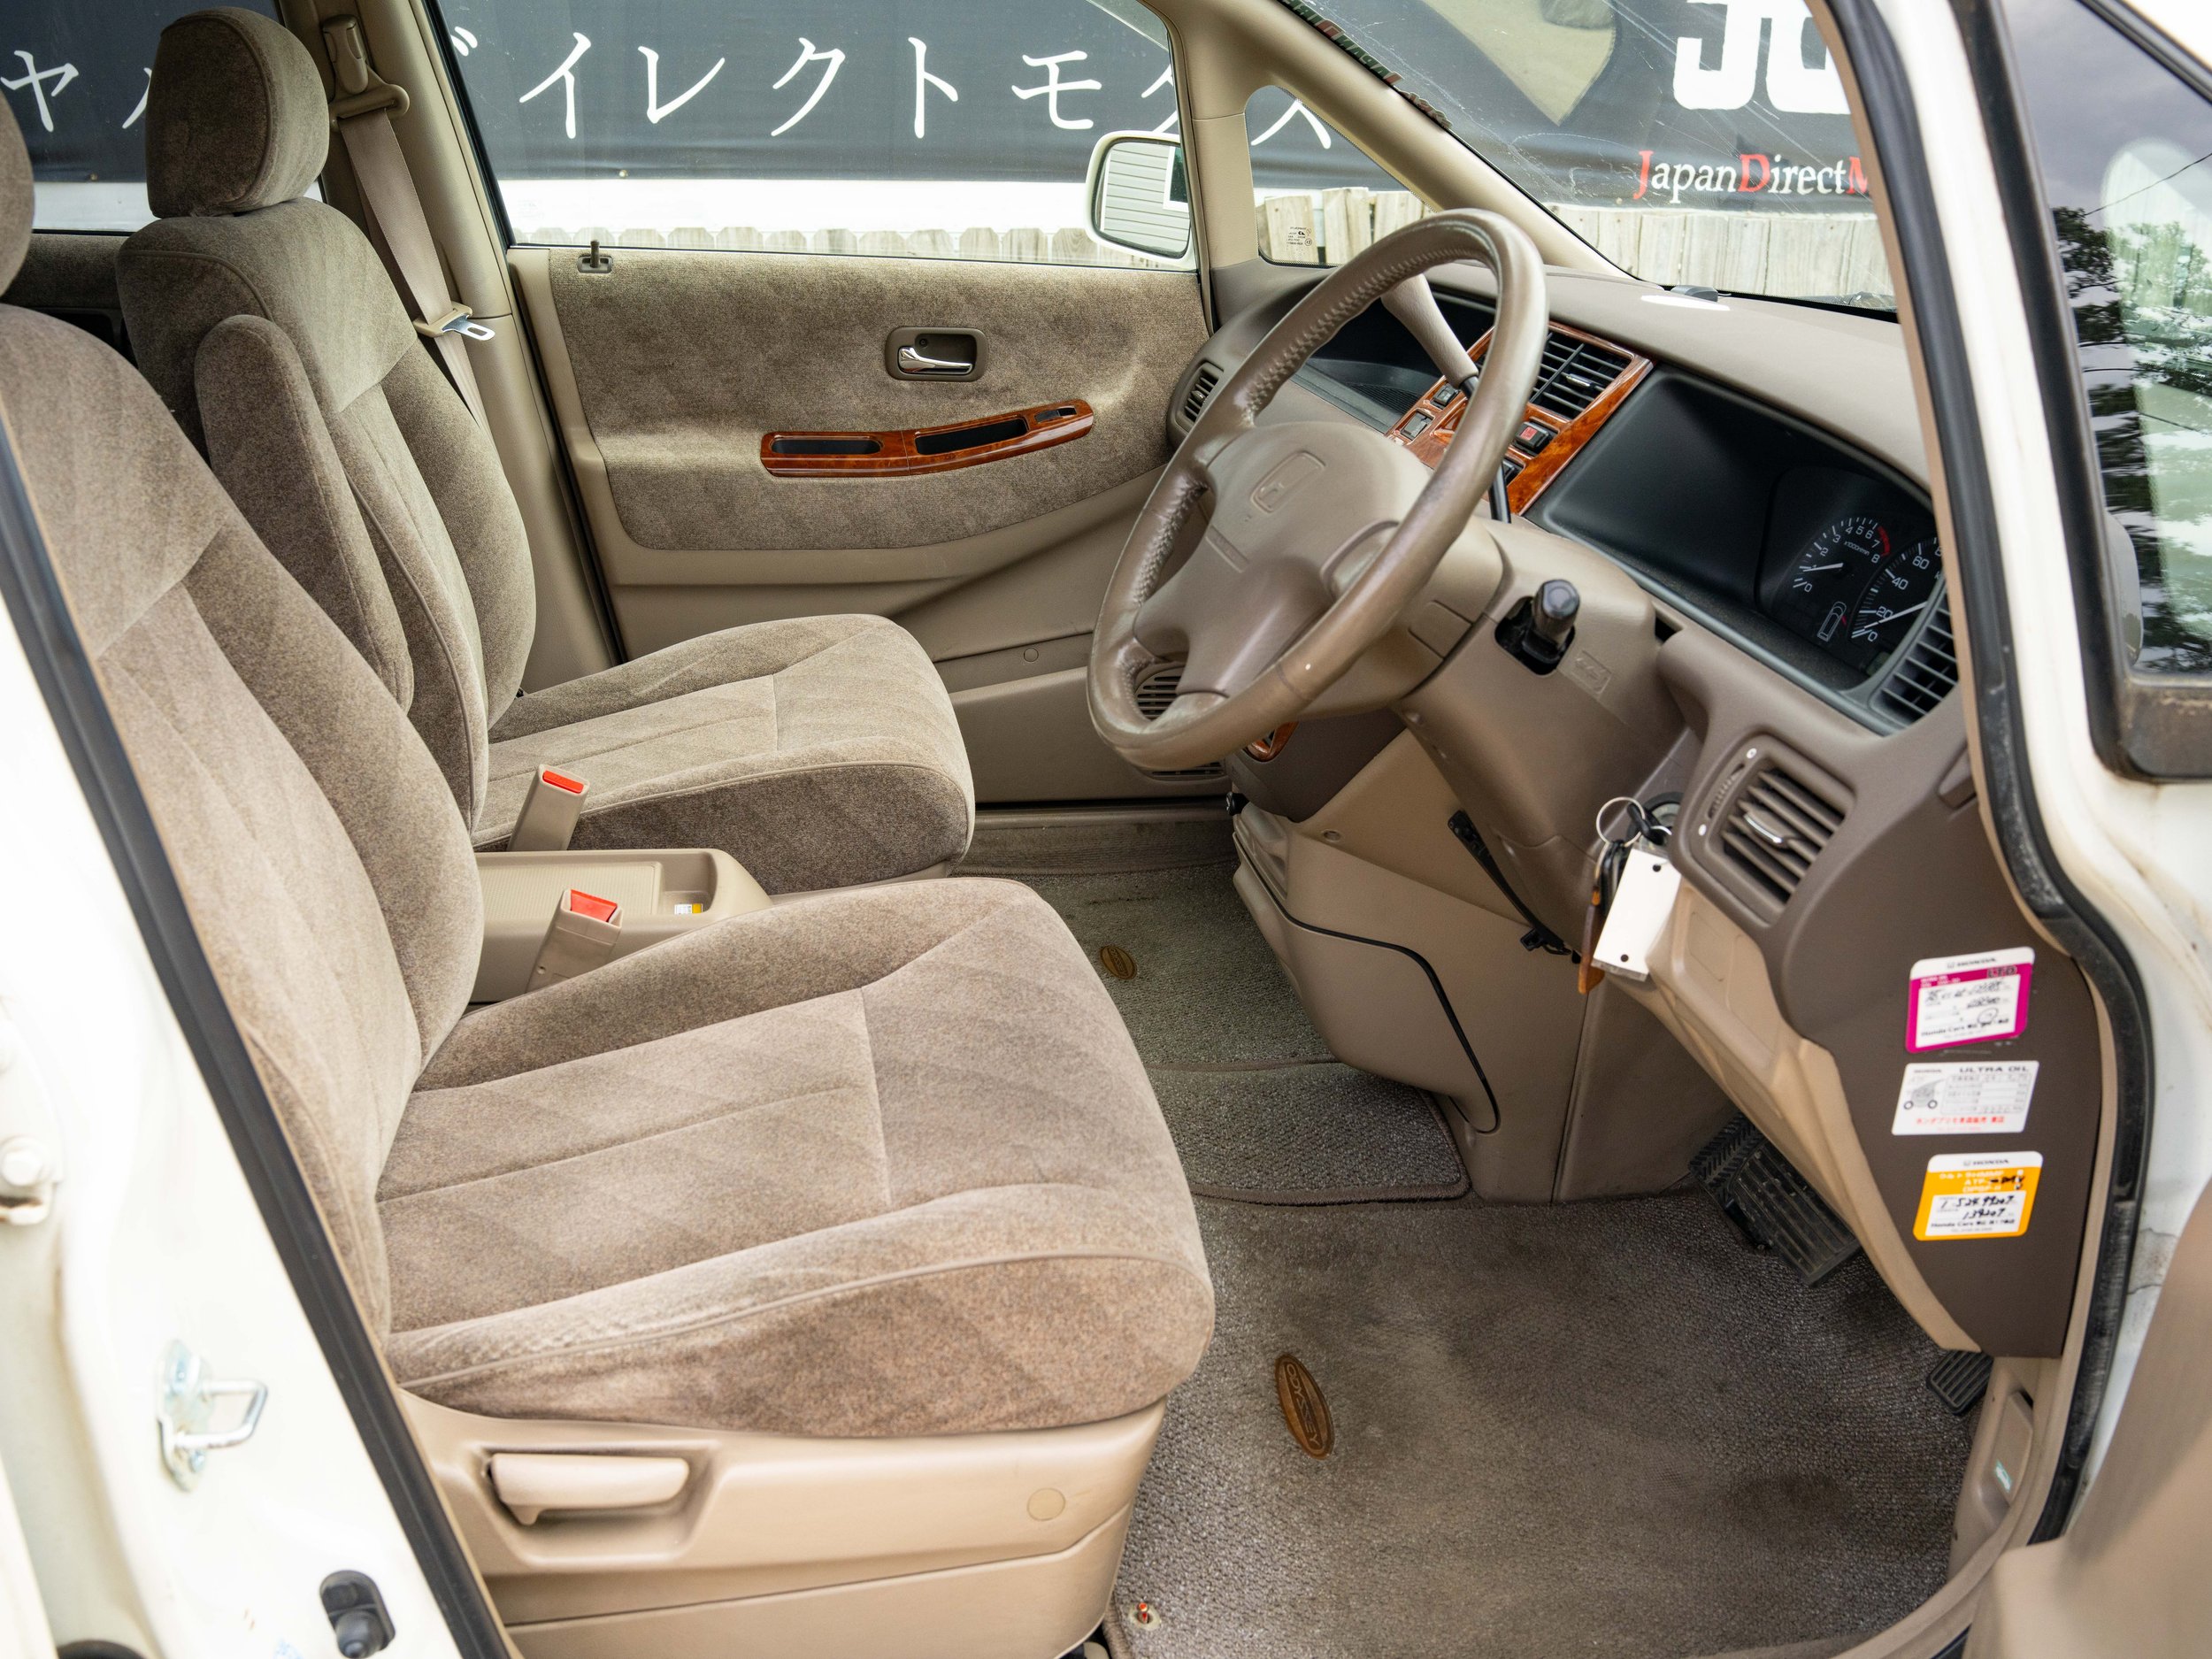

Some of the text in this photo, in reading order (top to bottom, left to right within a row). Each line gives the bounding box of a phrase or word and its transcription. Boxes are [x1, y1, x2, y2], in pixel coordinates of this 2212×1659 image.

[1855, 526, 1863, 535] 5
[1865, 530, 1874, 539] 6
[1832, 534, 1841, 543] 3
[1871, 540, 1880, 549] 7
[1820, 548, 1829, 557] 2
[1871, 554, 1880, 564] 8
[1867, 556, 1930, 641] 0 20 40 60
